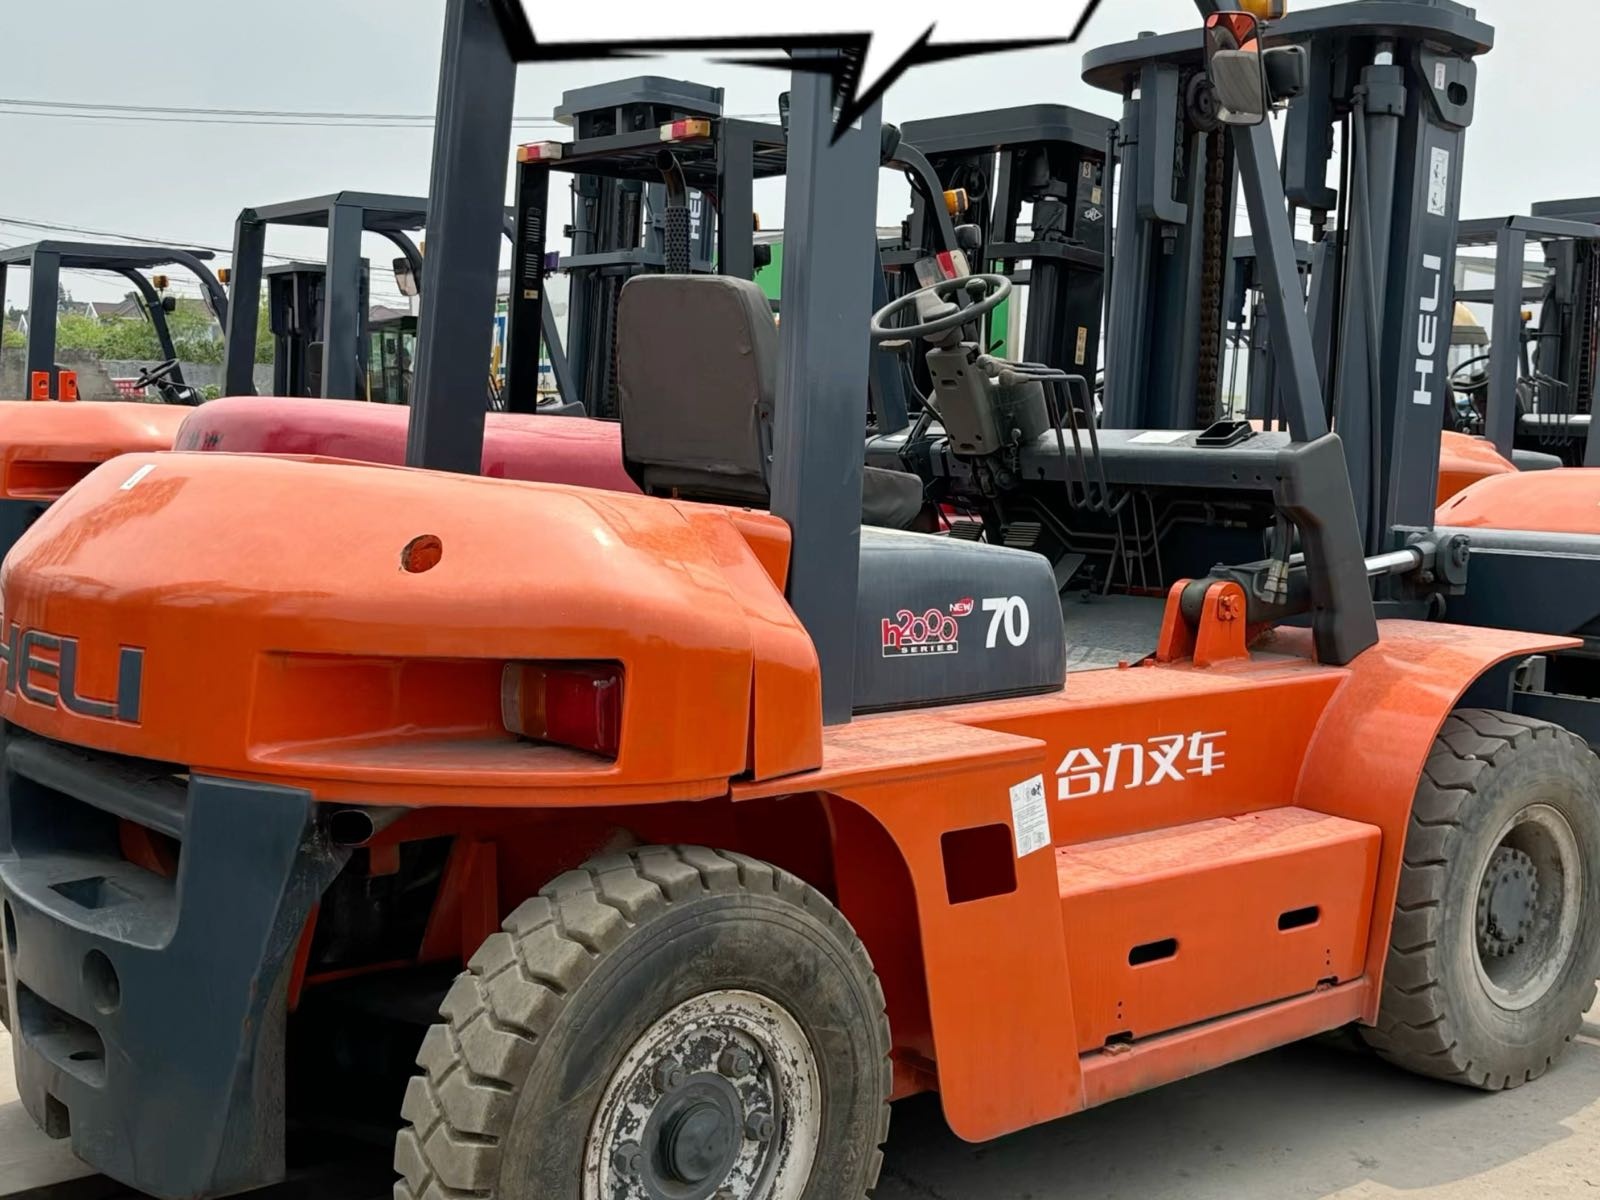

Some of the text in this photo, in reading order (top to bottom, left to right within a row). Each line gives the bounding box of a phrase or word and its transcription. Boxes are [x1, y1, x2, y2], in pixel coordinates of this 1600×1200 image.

[689, 190, 702, 240] HEL
[1413, 253, 1441, 405] HELI
[949, 602, 972, 613] NEW
[982, 595, 1030, 648] 70
[901, 644, 954, 653] SERIES
[1055, 731, 1227, 801] 合力叉车
